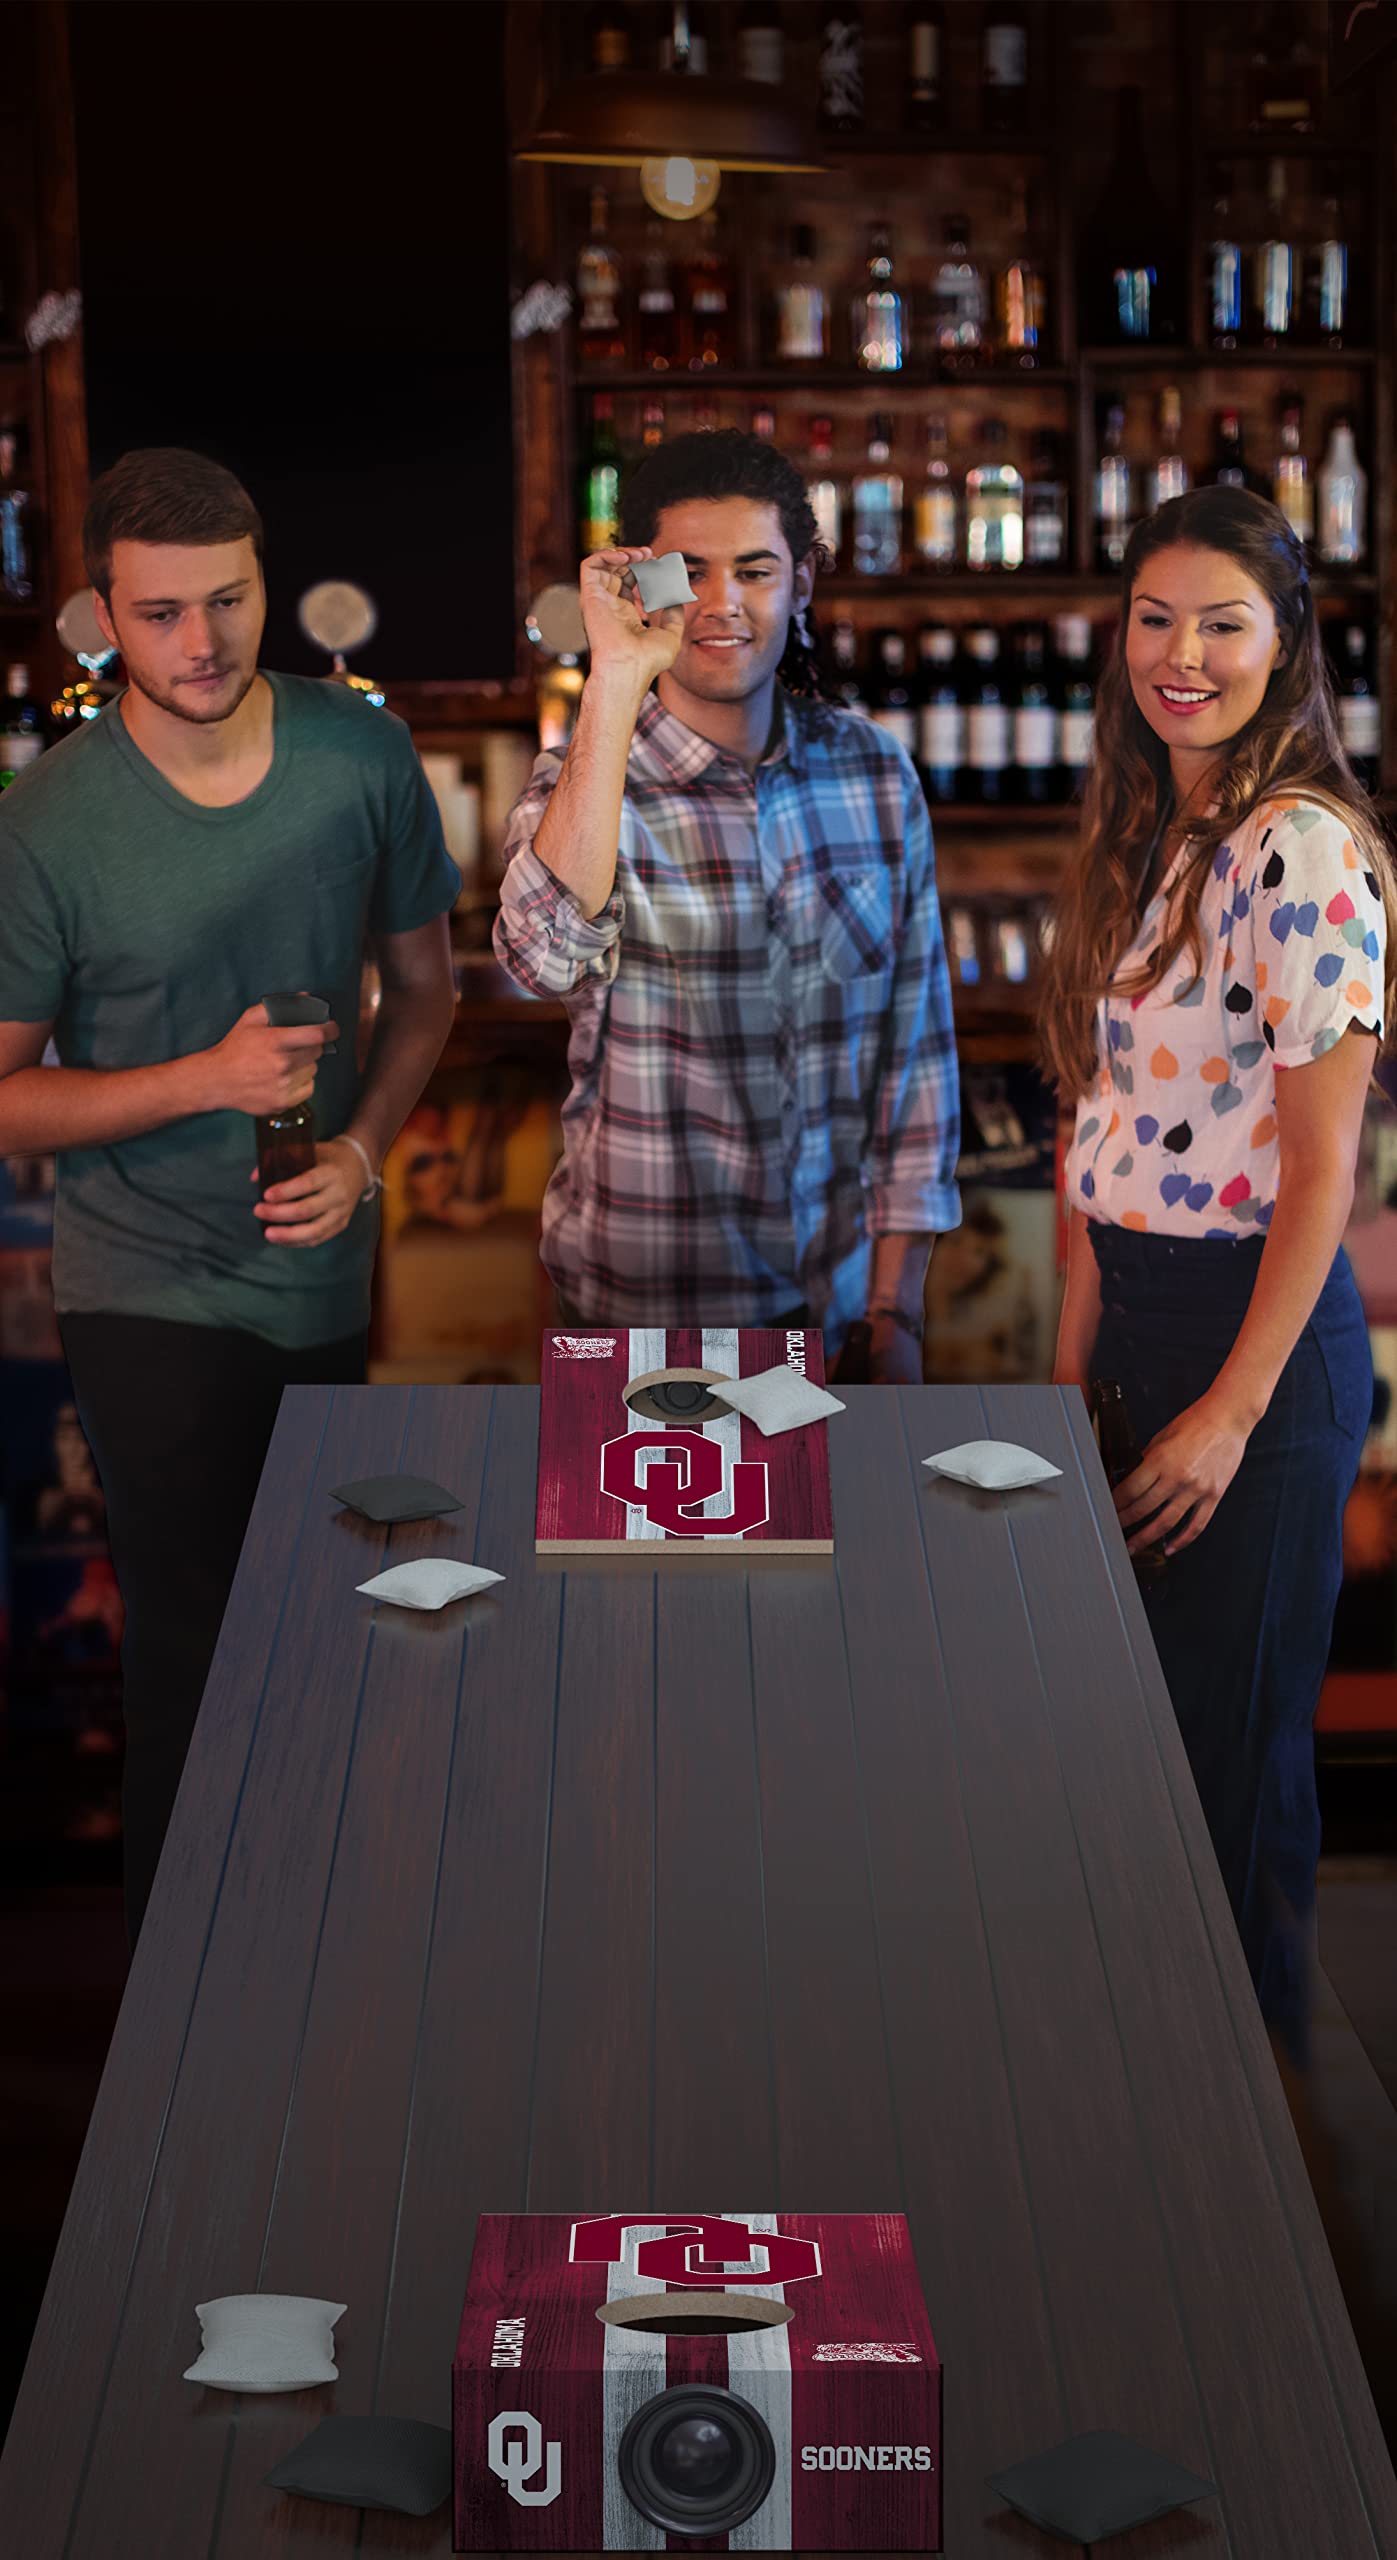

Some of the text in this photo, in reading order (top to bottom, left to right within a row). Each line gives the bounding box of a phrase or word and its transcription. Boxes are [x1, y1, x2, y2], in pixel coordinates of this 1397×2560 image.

[786, 1331, 806, 1378] OKLAHO
[600, 1430, 770, 1536] OU
[490, 2317, 526, 2368] OKLAHOMA
[488, 2411, 562, 2506] OU
[801, 2446, 931, 2471] SOONERS
